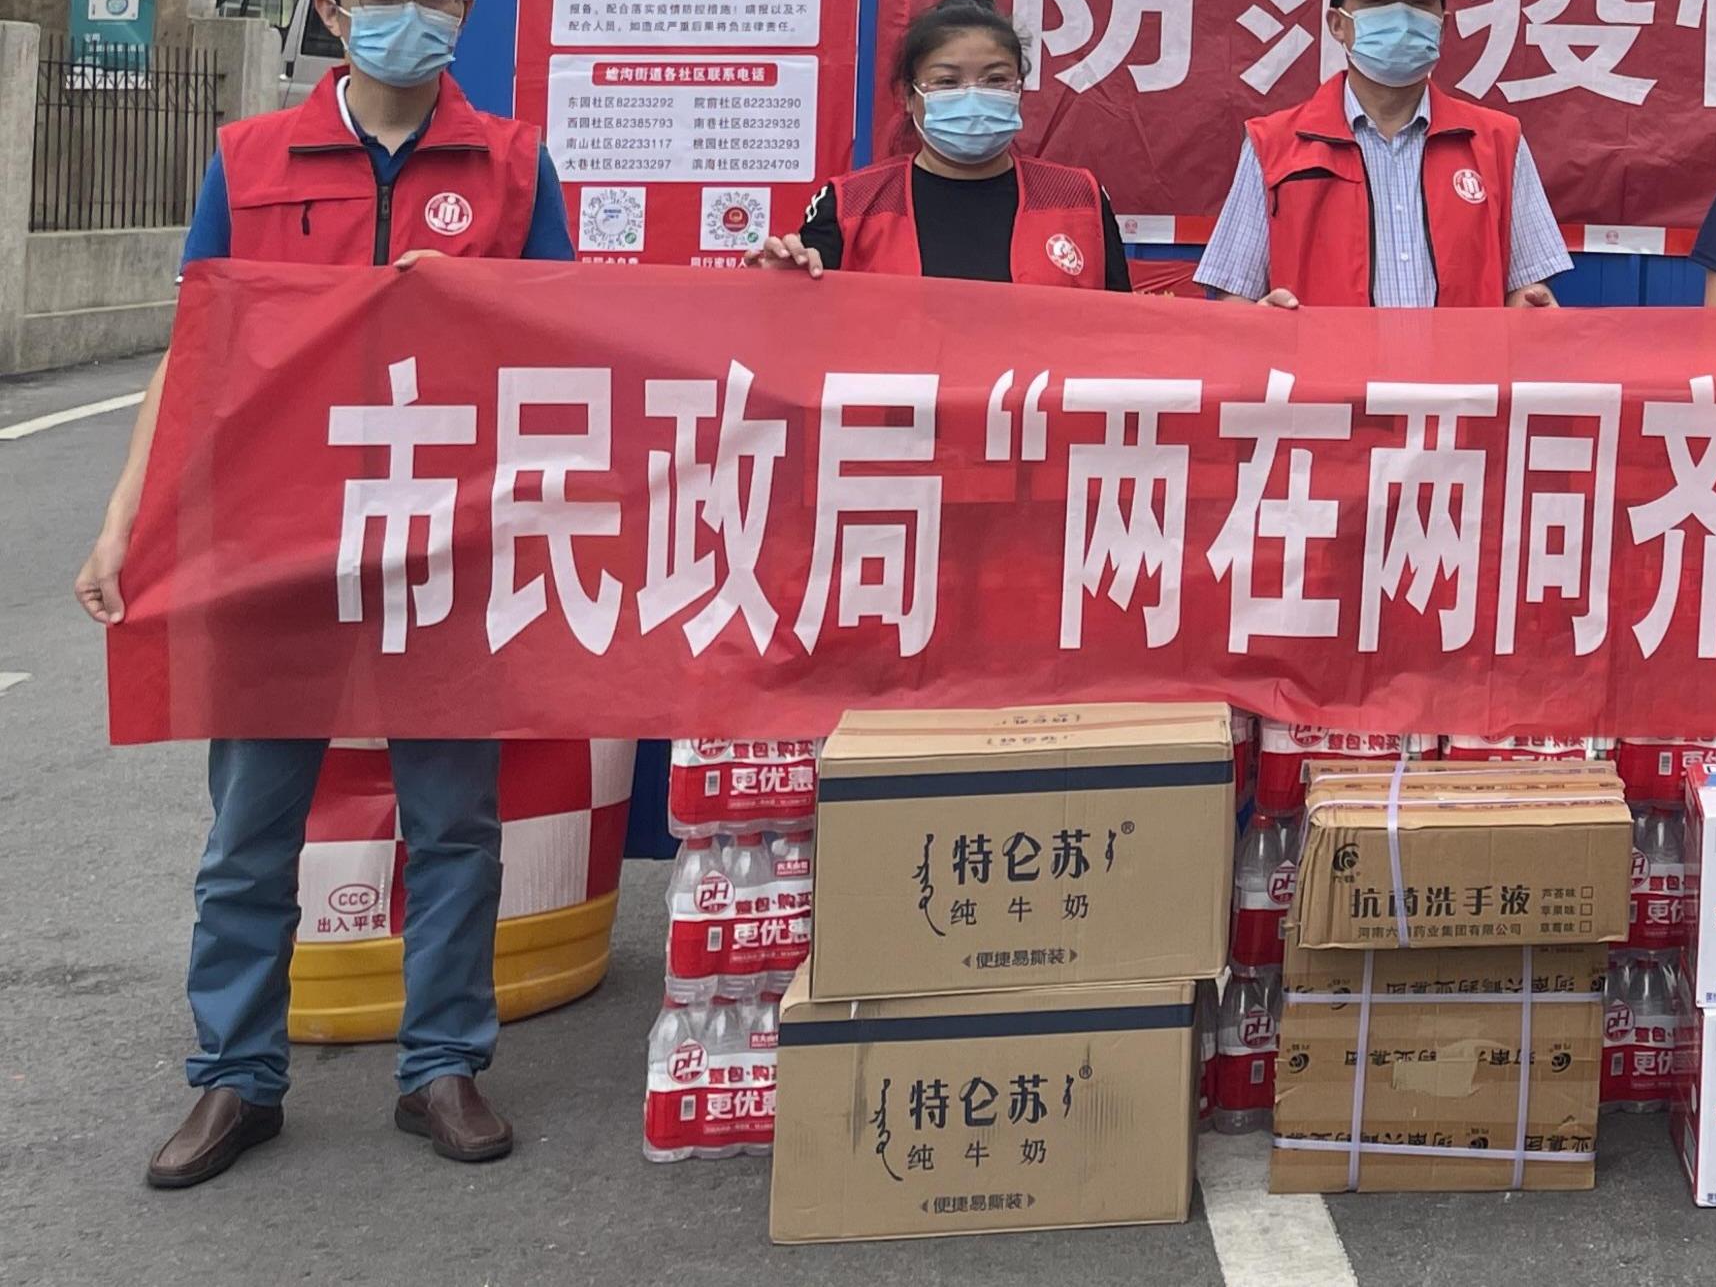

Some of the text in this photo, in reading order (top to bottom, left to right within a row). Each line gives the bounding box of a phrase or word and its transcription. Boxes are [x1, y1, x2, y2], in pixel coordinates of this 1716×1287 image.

[730, 766, 815, 796] 更优惠
[952, 829, 1091, 885] 特仑苏
[338, 892, 370, 906] CCC
[950, 894, 1090, 926] 纯牛奶
[1352, 884, 1531, 919] 抗菌洗手液
[317, 913, 387, 934] 出入平安
[1358, 922, 1522, 939] 河南六药业集团有限公司
[909, 1074, 1049, 1130] 特仑苏
[907, 1138, 1047, 1171] 纯牛奶
